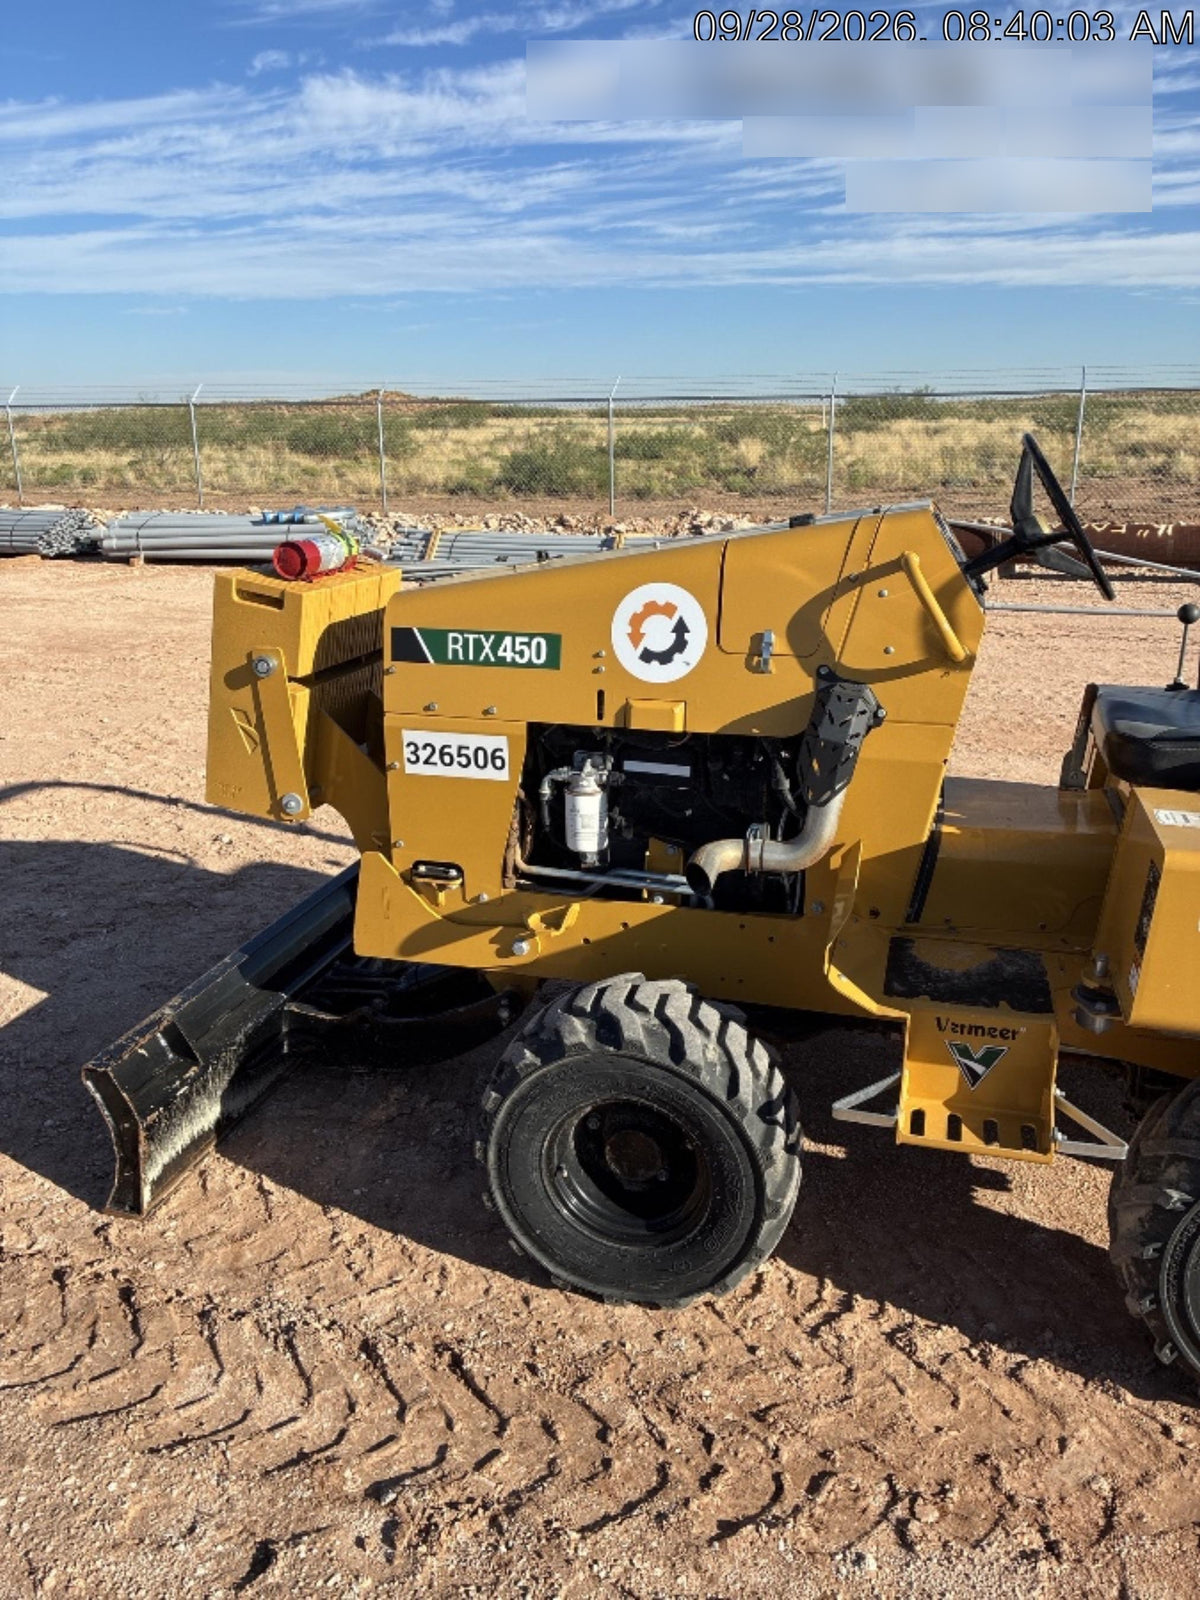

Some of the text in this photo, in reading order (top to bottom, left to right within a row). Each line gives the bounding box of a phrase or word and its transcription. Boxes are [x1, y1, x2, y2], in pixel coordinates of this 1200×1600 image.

[447, 632, 547, 665] RTX450
[405, 741, 506, 771] 326506
[936, 1016, 1019, 1040] Vermeer
